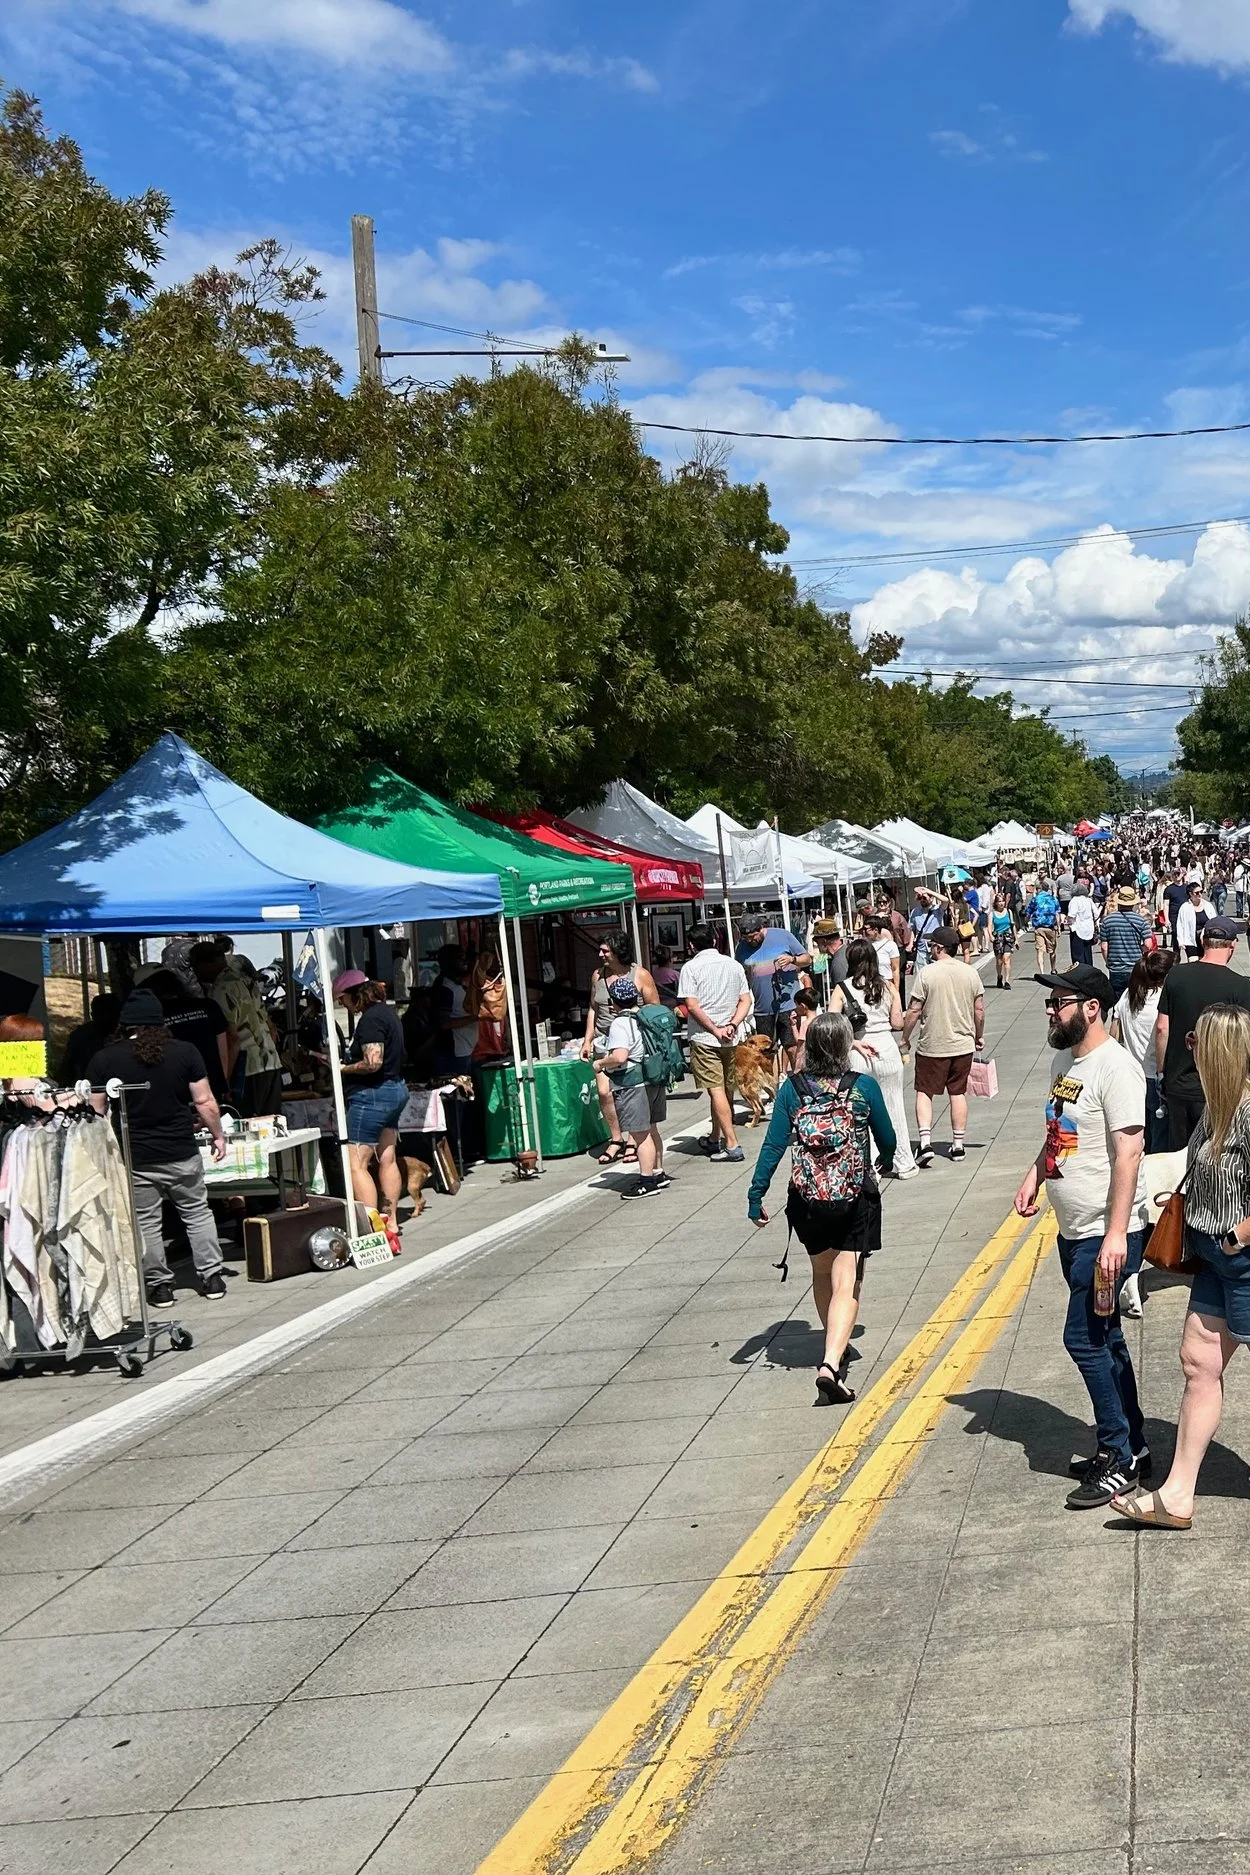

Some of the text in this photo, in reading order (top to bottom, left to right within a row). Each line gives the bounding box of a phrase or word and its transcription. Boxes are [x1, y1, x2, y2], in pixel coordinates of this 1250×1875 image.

[540, 881, 559, 889] PORTLAND
[559, 879, 571, 888] PARKS
[573, 877, 595, 886] RECREATION
[359, 1252, 390, 1266] YOUR STEP
[360, 1248, 386, 1259] WATCH
